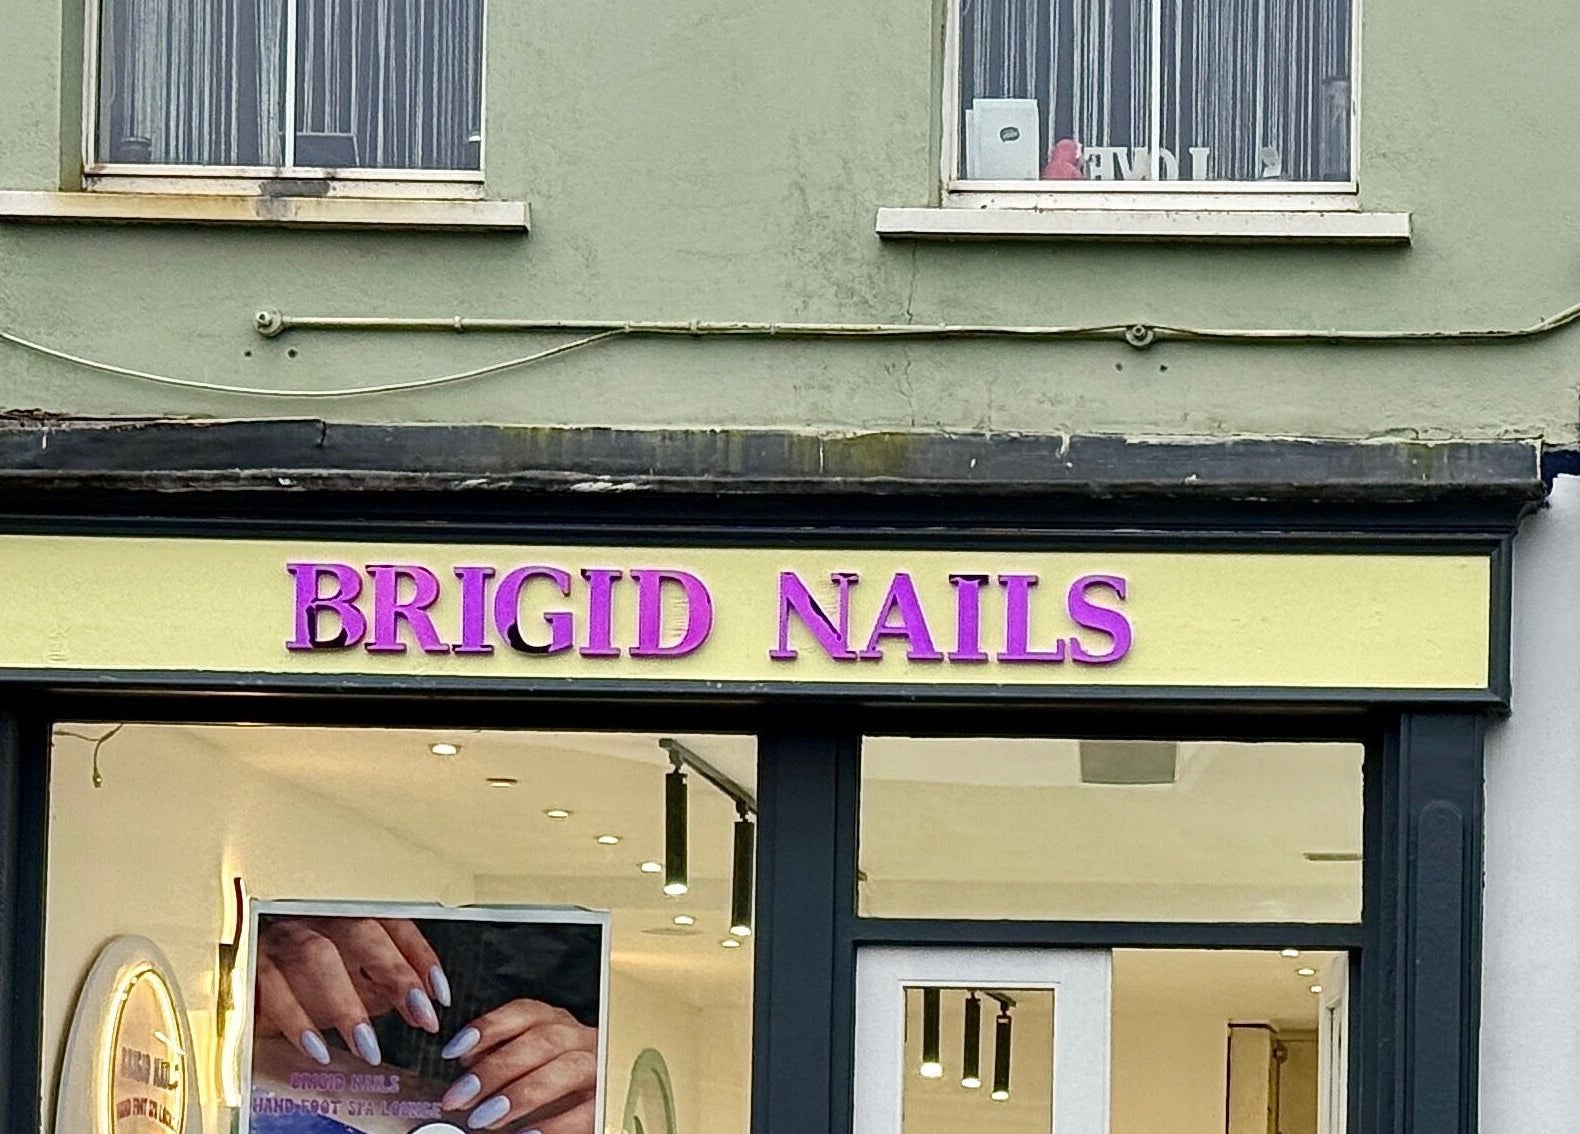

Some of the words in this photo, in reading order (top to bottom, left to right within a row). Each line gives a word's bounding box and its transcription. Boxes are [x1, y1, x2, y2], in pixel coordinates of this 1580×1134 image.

[287, 563, 714, 660] BRIGID
[771, 572, 1132, 664] NAILS
[253, 1097, 296, 1115] HAND
[301, 1099, 342, 1116] FOOT
[349, 1101, 374, 1117] SPA
